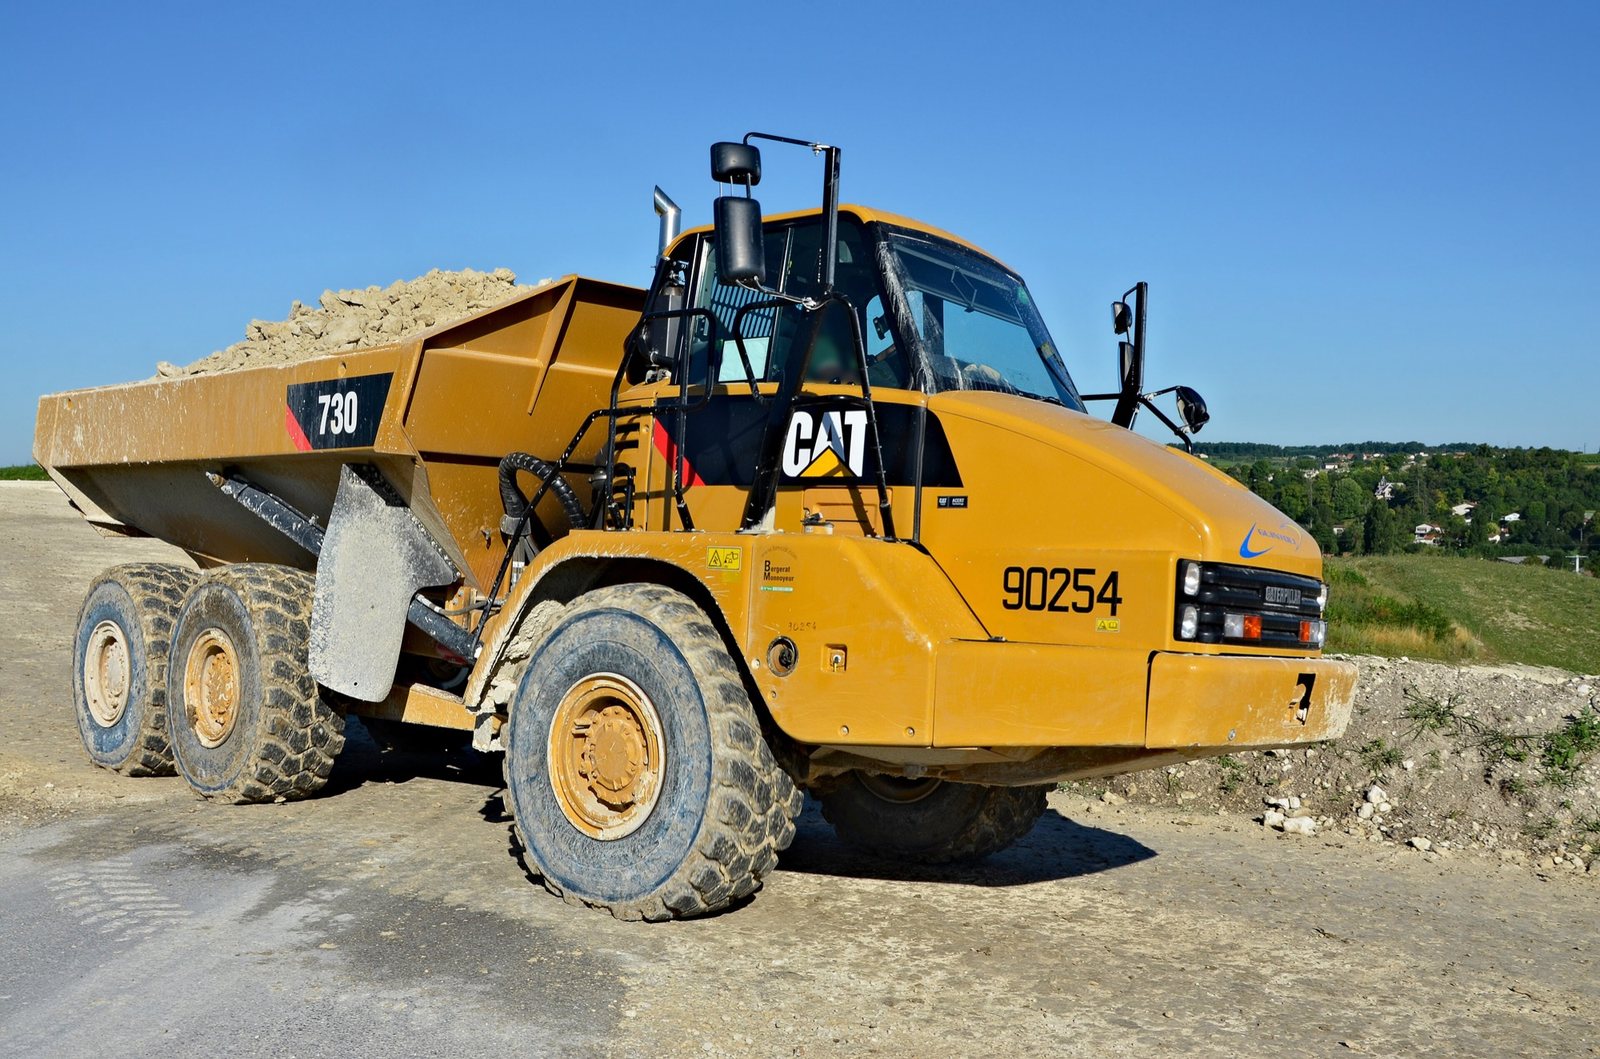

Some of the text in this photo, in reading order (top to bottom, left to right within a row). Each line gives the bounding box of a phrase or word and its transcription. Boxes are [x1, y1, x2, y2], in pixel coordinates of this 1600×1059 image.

[318, 391, 358, 435] 730
[782, 410, 868, 478] CAT
[763, 571, 794, 582] Monnoyeur
[764, 560, 791, 573] Bergerat
[1002, 566, 1123, 617] 90254
[1265, 586, 1302, 605] CATERPILLAR
